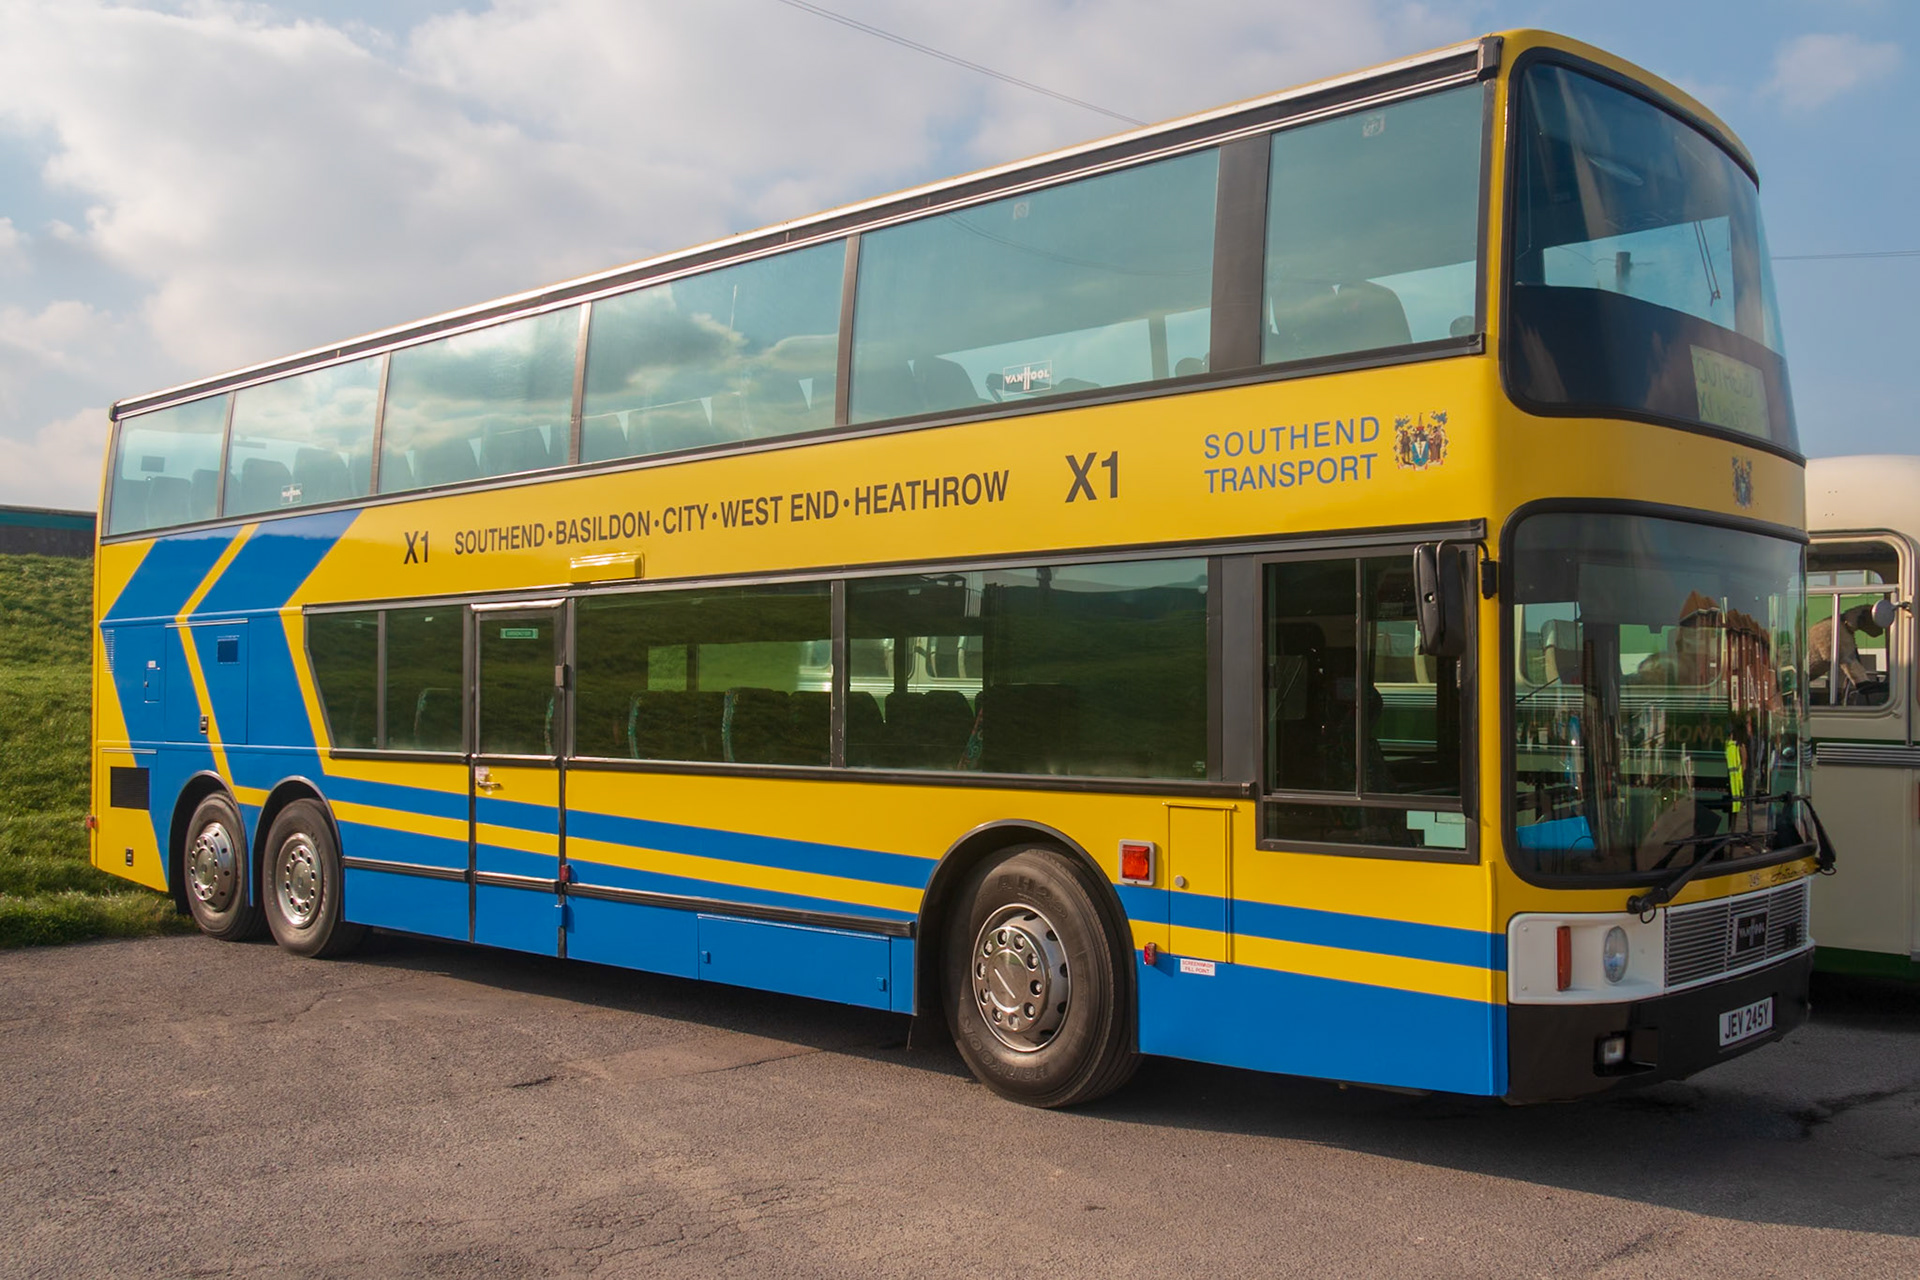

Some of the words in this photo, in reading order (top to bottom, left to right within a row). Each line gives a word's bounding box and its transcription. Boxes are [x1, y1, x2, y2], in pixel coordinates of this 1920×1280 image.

[1204, 416, 1380, 459] SOUTHEND
[1065, 451, 1119, 503] X1
[1204, 453, 1378, 494] TRANSPORT
[454, 523, 546, 556] SOUTHEND
[556, 511, 650, 546] BASILDON
[662, 503, 710, 536] CITY
[720, 496, 784, 530] WEST
[791, 489, 840, 523] END
[854, 469, 1011, 516] HEATHROW
[403, 531, 430, 565] X1
[1725, 1010, 1744, 1039] JEV
[1746, 1001, 1770, 1031] 245Y
